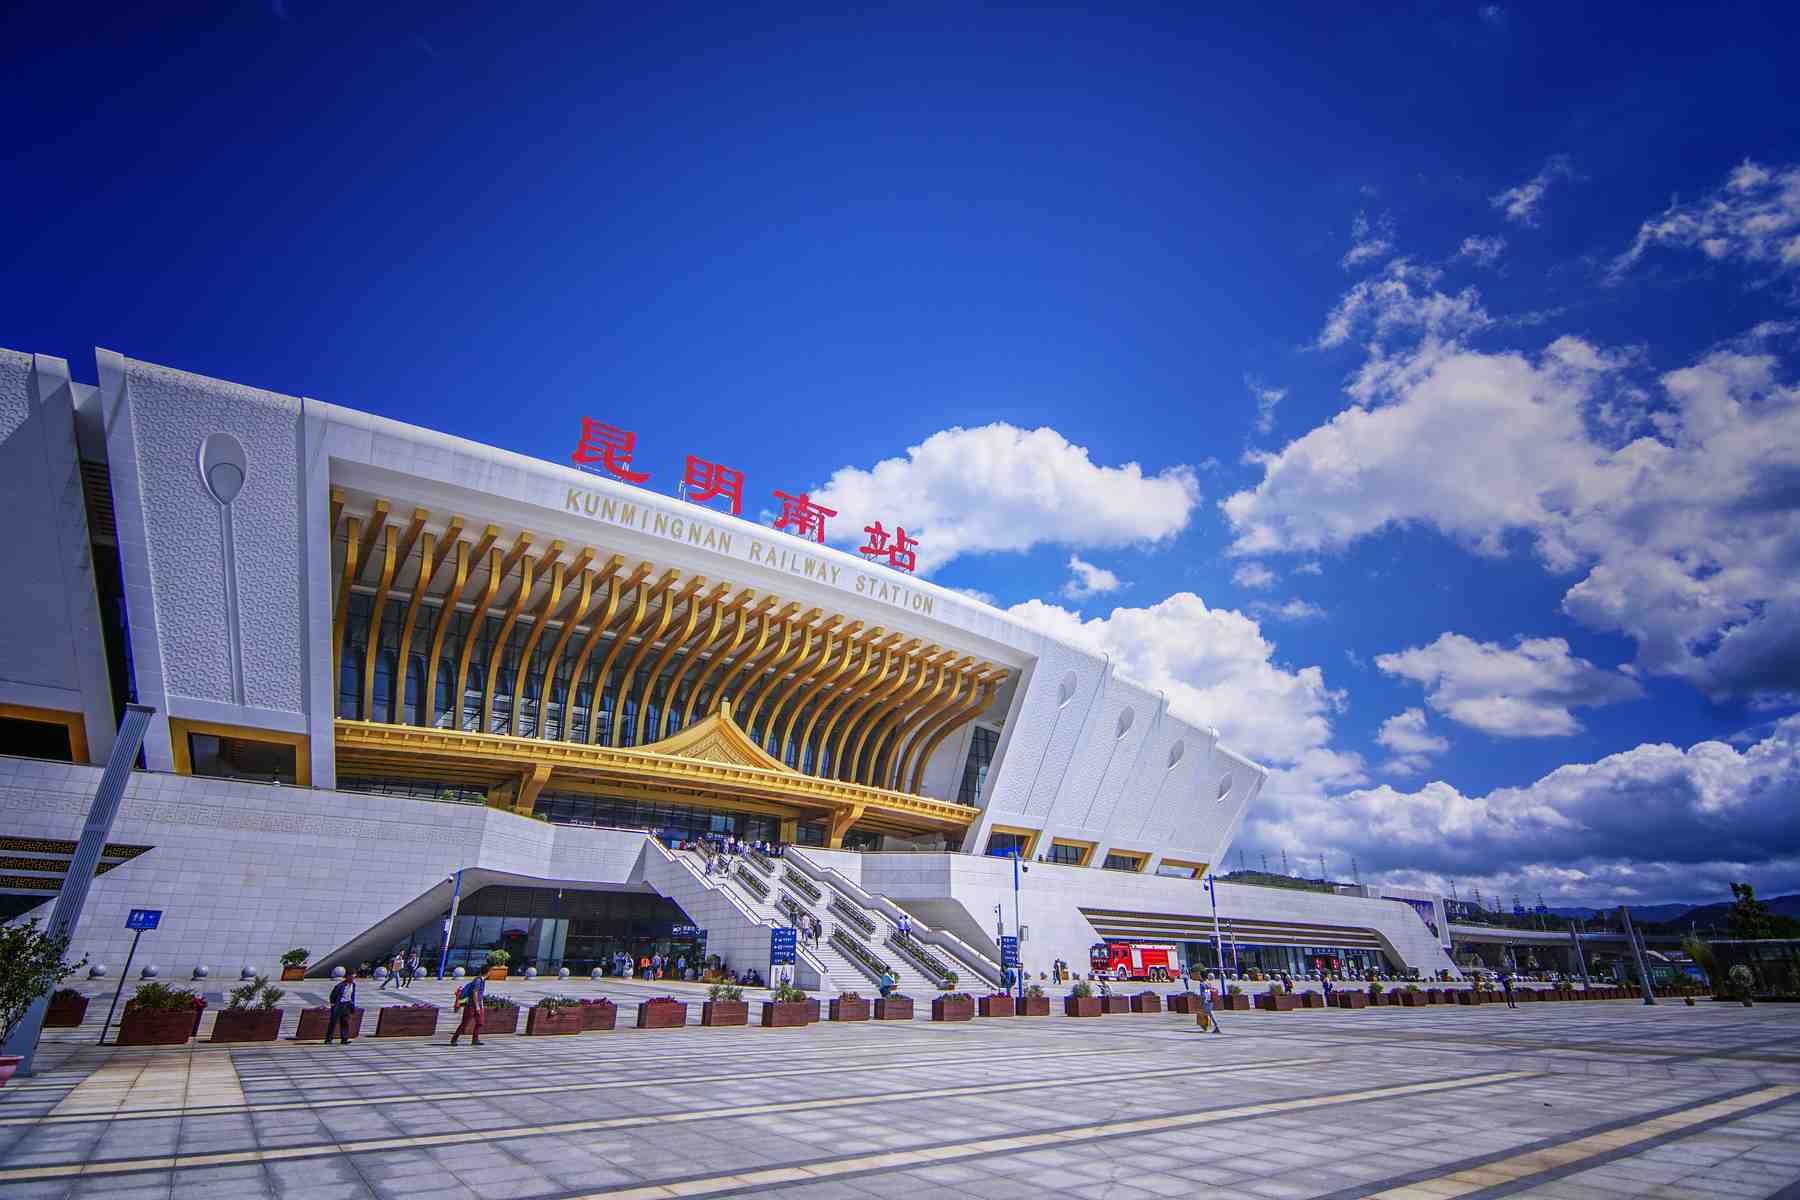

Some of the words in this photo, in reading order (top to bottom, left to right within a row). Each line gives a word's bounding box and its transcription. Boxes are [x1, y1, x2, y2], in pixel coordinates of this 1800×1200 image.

[566, 488, 732, 553] KUNMINGNAN
[751, 540, 841, 585] RAILWAY
[855, 575, 934, 614] STATION
[572, 416, 919, 572] 昆明南站
